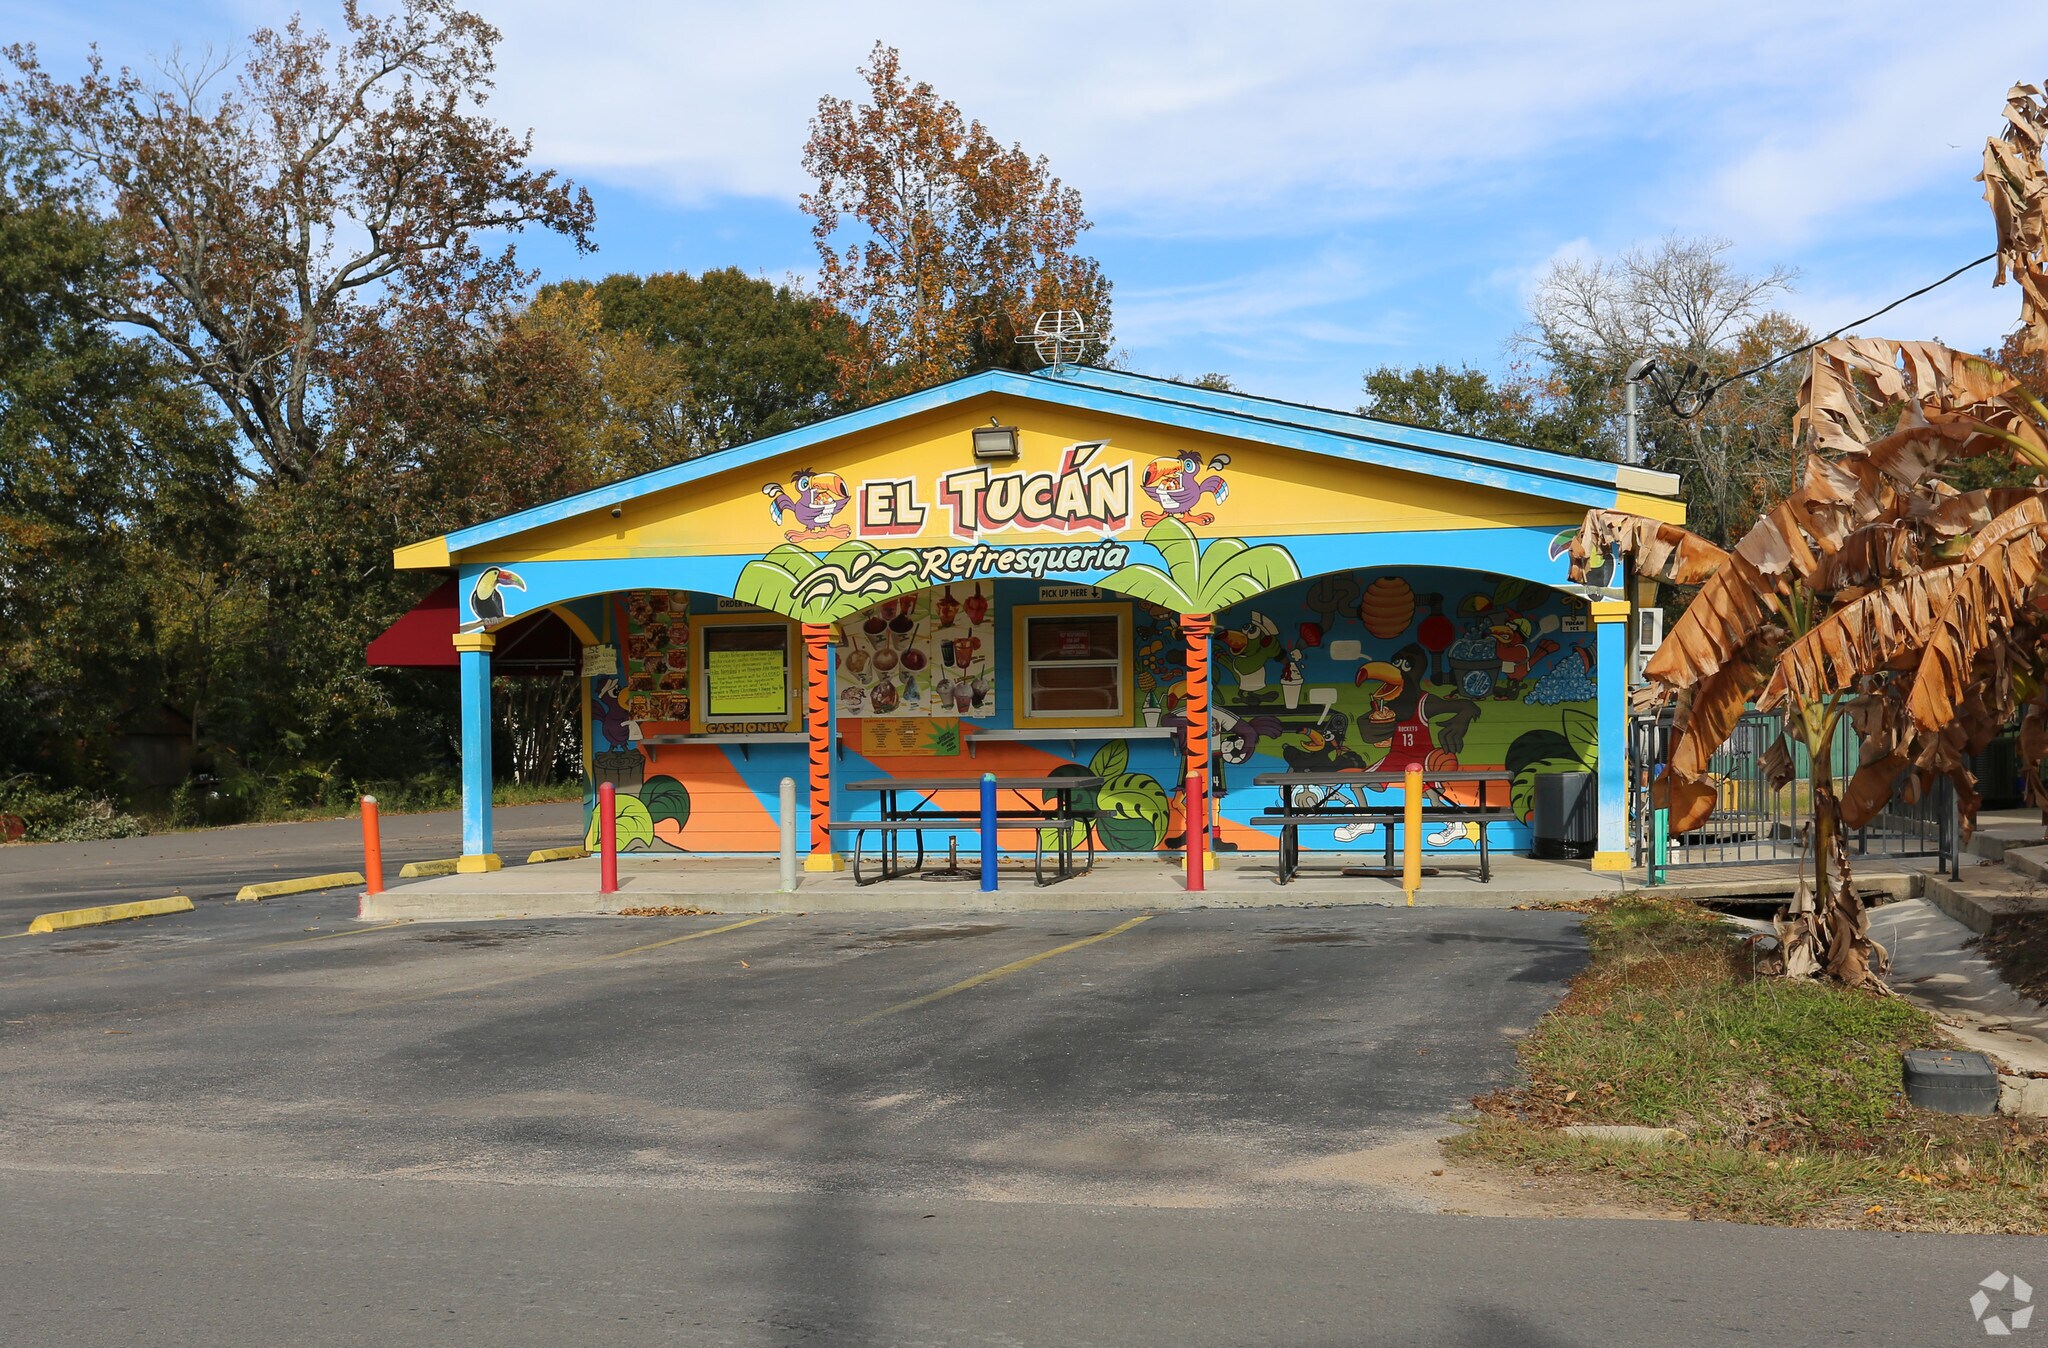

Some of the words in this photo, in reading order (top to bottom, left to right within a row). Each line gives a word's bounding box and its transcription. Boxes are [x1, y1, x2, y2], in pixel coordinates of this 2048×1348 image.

[860, 480, 927, 534] EL
[942, 442, 1129, 535] TUCÁN
[1041, 590, 1057, 598] PICK
[1059, 589, 1068, 597] UP
[1070, 588, 1087, 597] HERE
[720, 600, 743, 608] ORDER
[706, 723, 744, 734] CASH
[746, 722, 788, 733] ONLY
[1402, 733, 1413, 747] 13
